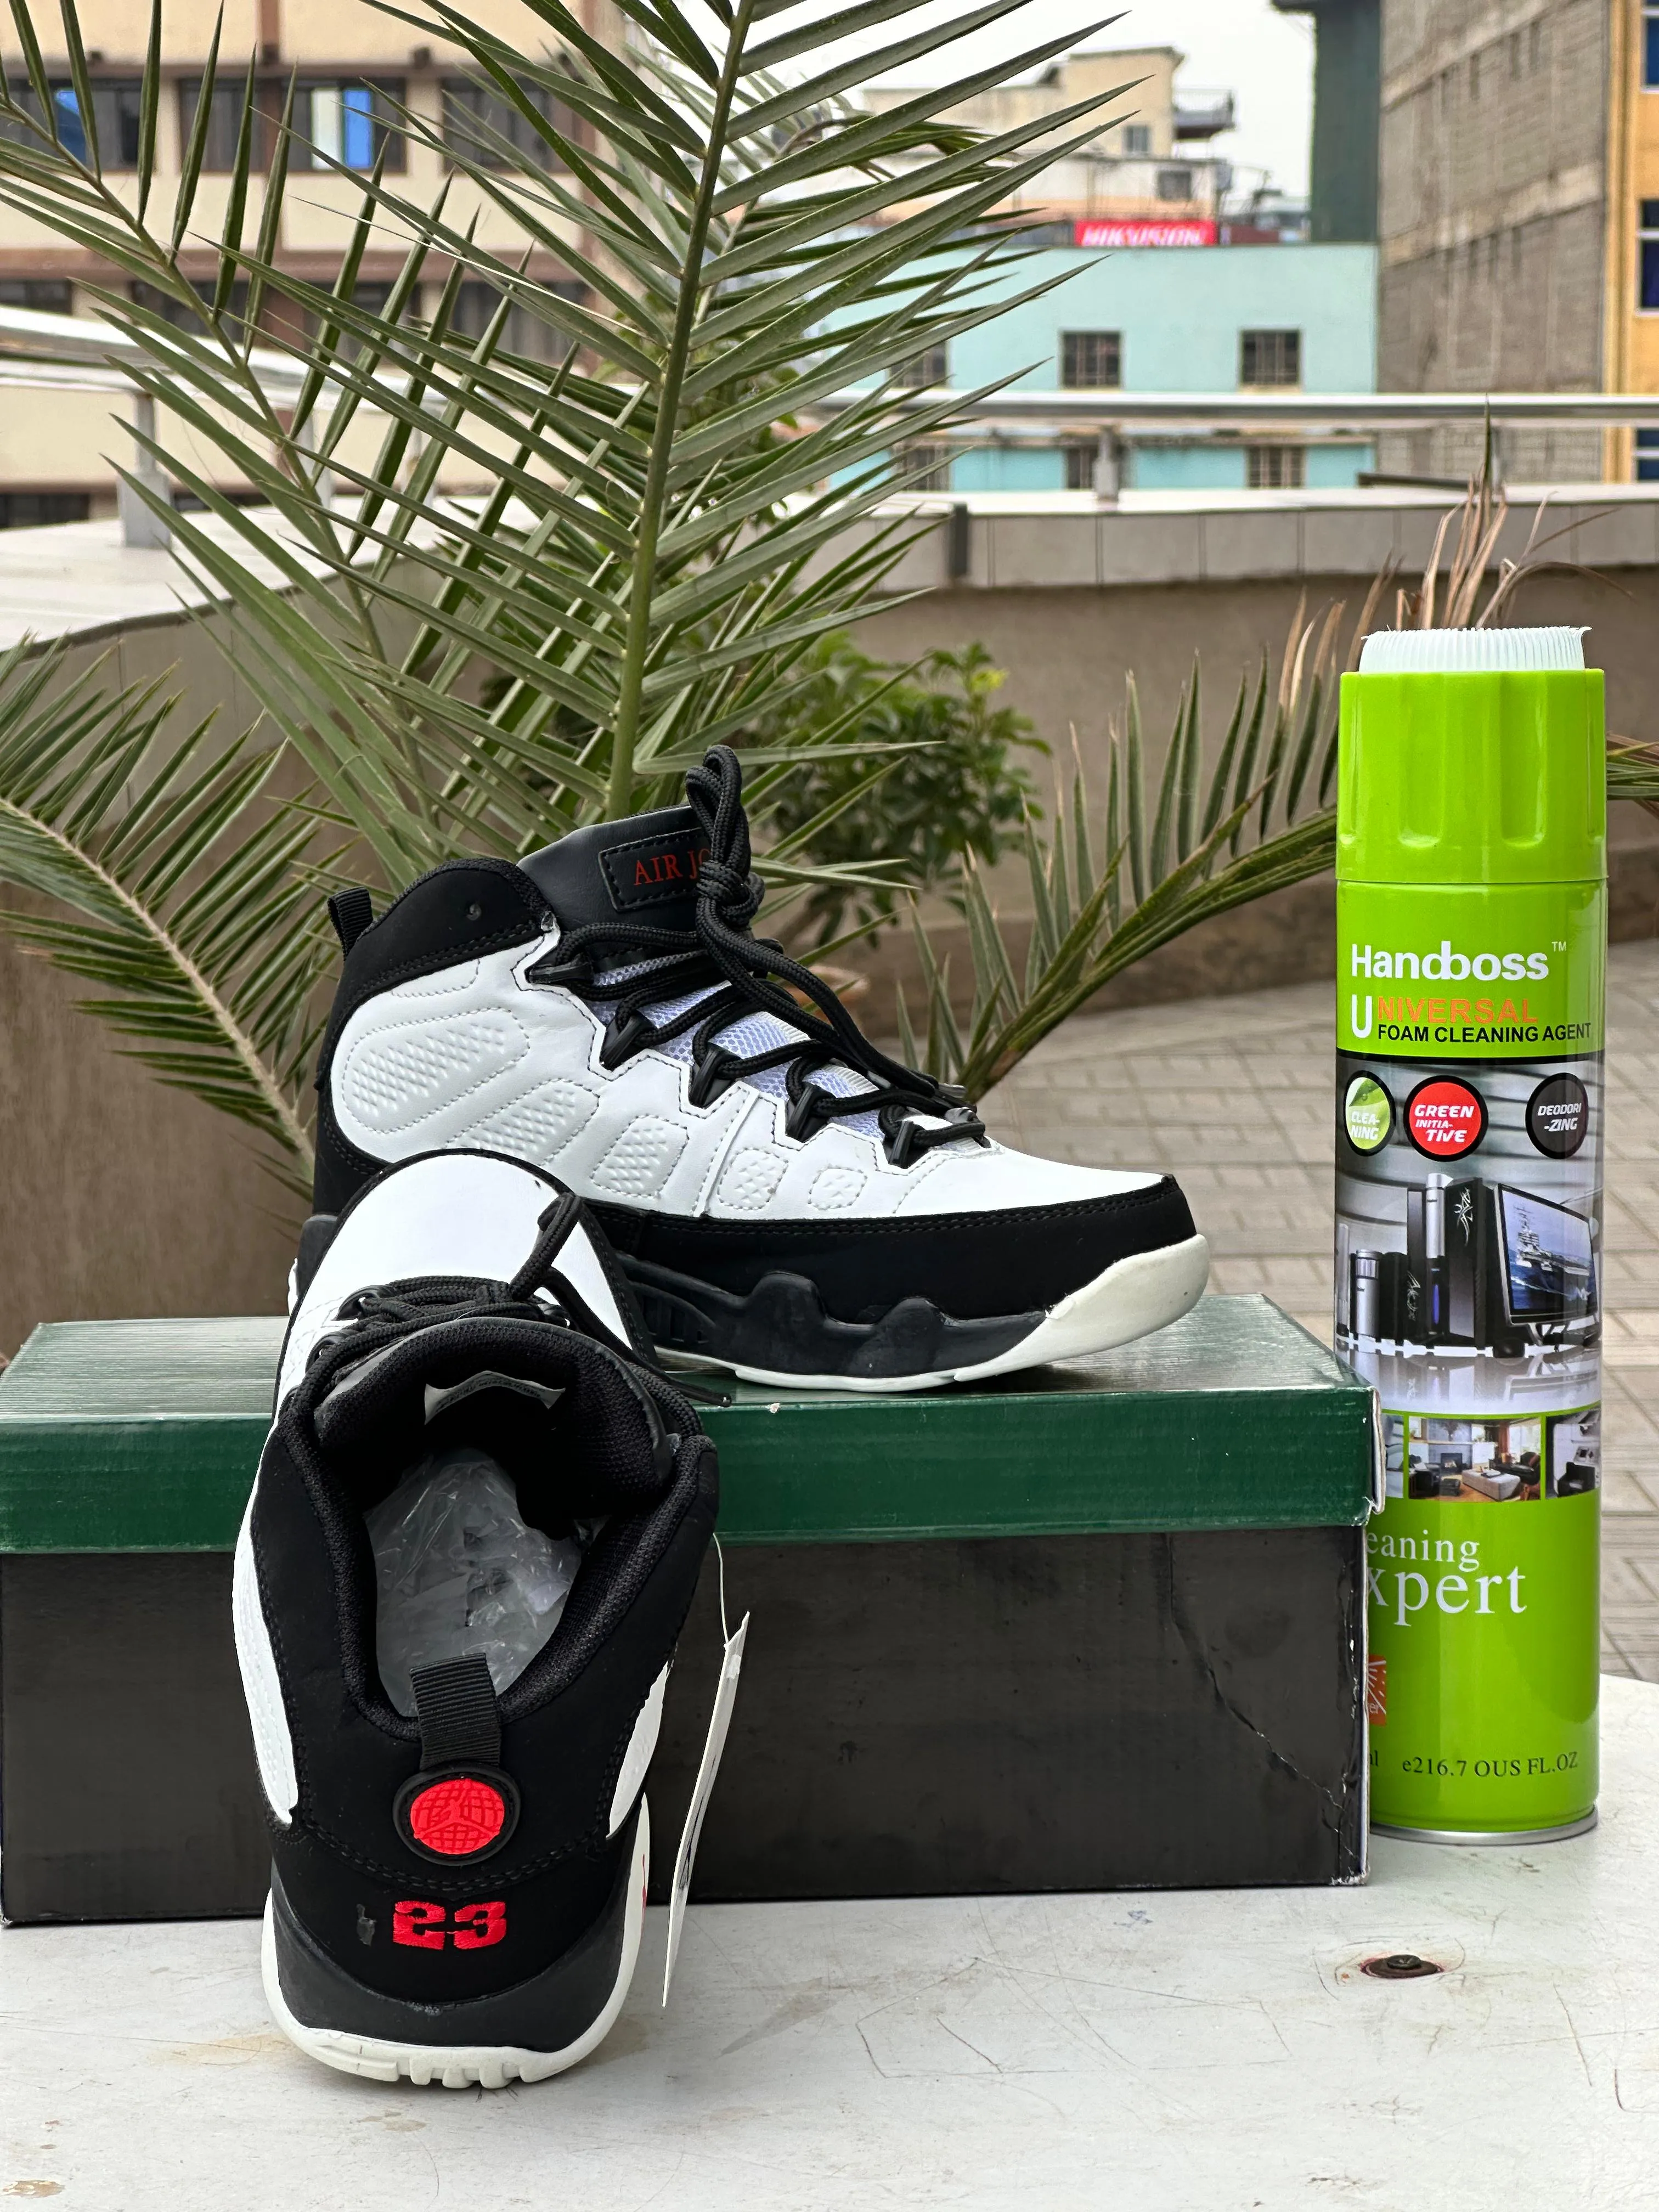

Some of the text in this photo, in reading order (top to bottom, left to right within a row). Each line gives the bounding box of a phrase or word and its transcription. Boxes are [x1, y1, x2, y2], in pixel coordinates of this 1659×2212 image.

[634, 854, 683, 885] AIR
[1351, 940, 1549, 981] Handboss
[1351, 994, 1538, 1039] UNIVERSAL
[1378, 1022, 1592, 1043] FOAM CLEANING AGENT
[1414, 1104, 1475, 1118] GREEN
[1537, 1103, 1582, 1116] DEODORI
[1351, 1111, 1380, 1125] CLEA-
[1415, 1119, 1453, 1129] INITIA-
[1544, 1117, 1578, 1131] -ZING
[1351, 1126, 1379, 1141] NING
[1426, 1129, 1468, 1143] TIVE
[1474, 1759, 1521, 1777] OUS
[393, 1901, 507, 1950] 23
